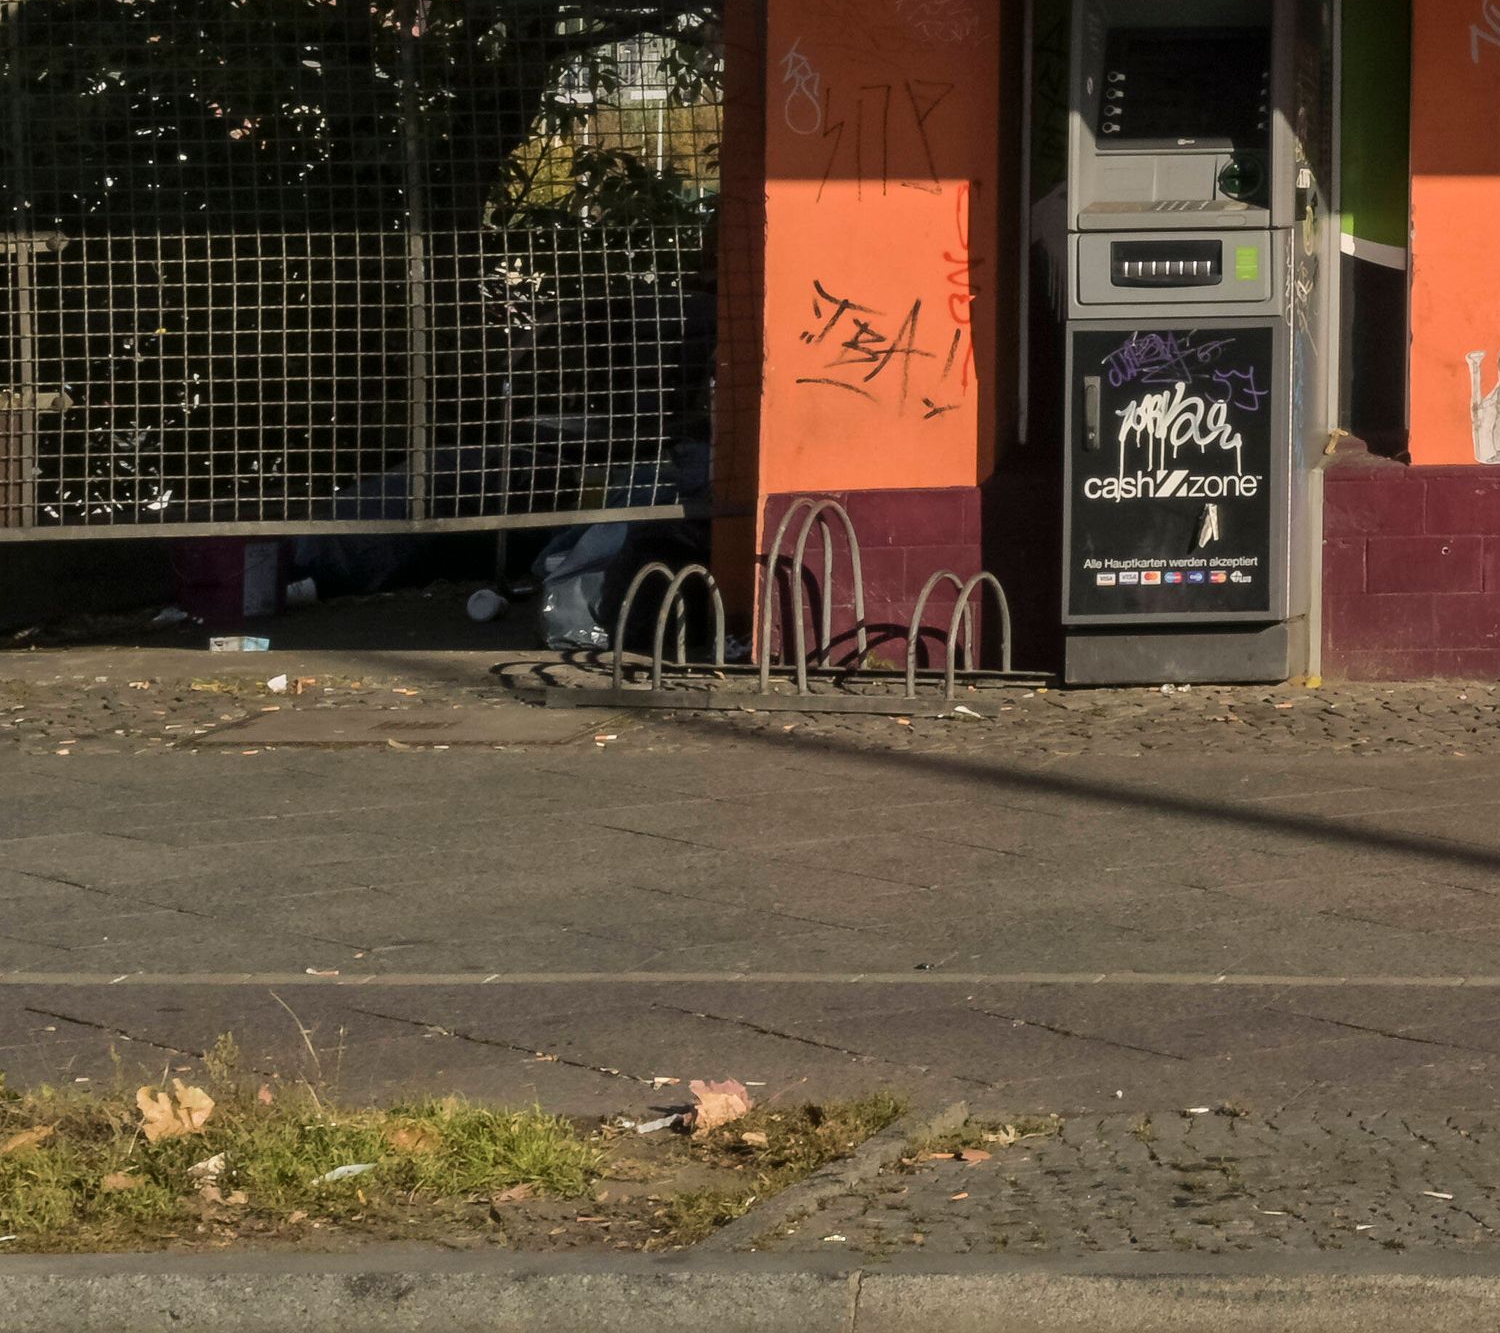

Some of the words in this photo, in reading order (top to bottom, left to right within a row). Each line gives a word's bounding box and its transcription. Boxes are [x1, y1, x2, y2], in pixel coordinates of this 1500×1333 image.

[1084, 559, 1102, 569] Alle
[1104, 558, 1166, 570] Hauptkarten
[1169, 558, 1207, 567] werden
[1209, 556, 1259, 568] akzeptiert
